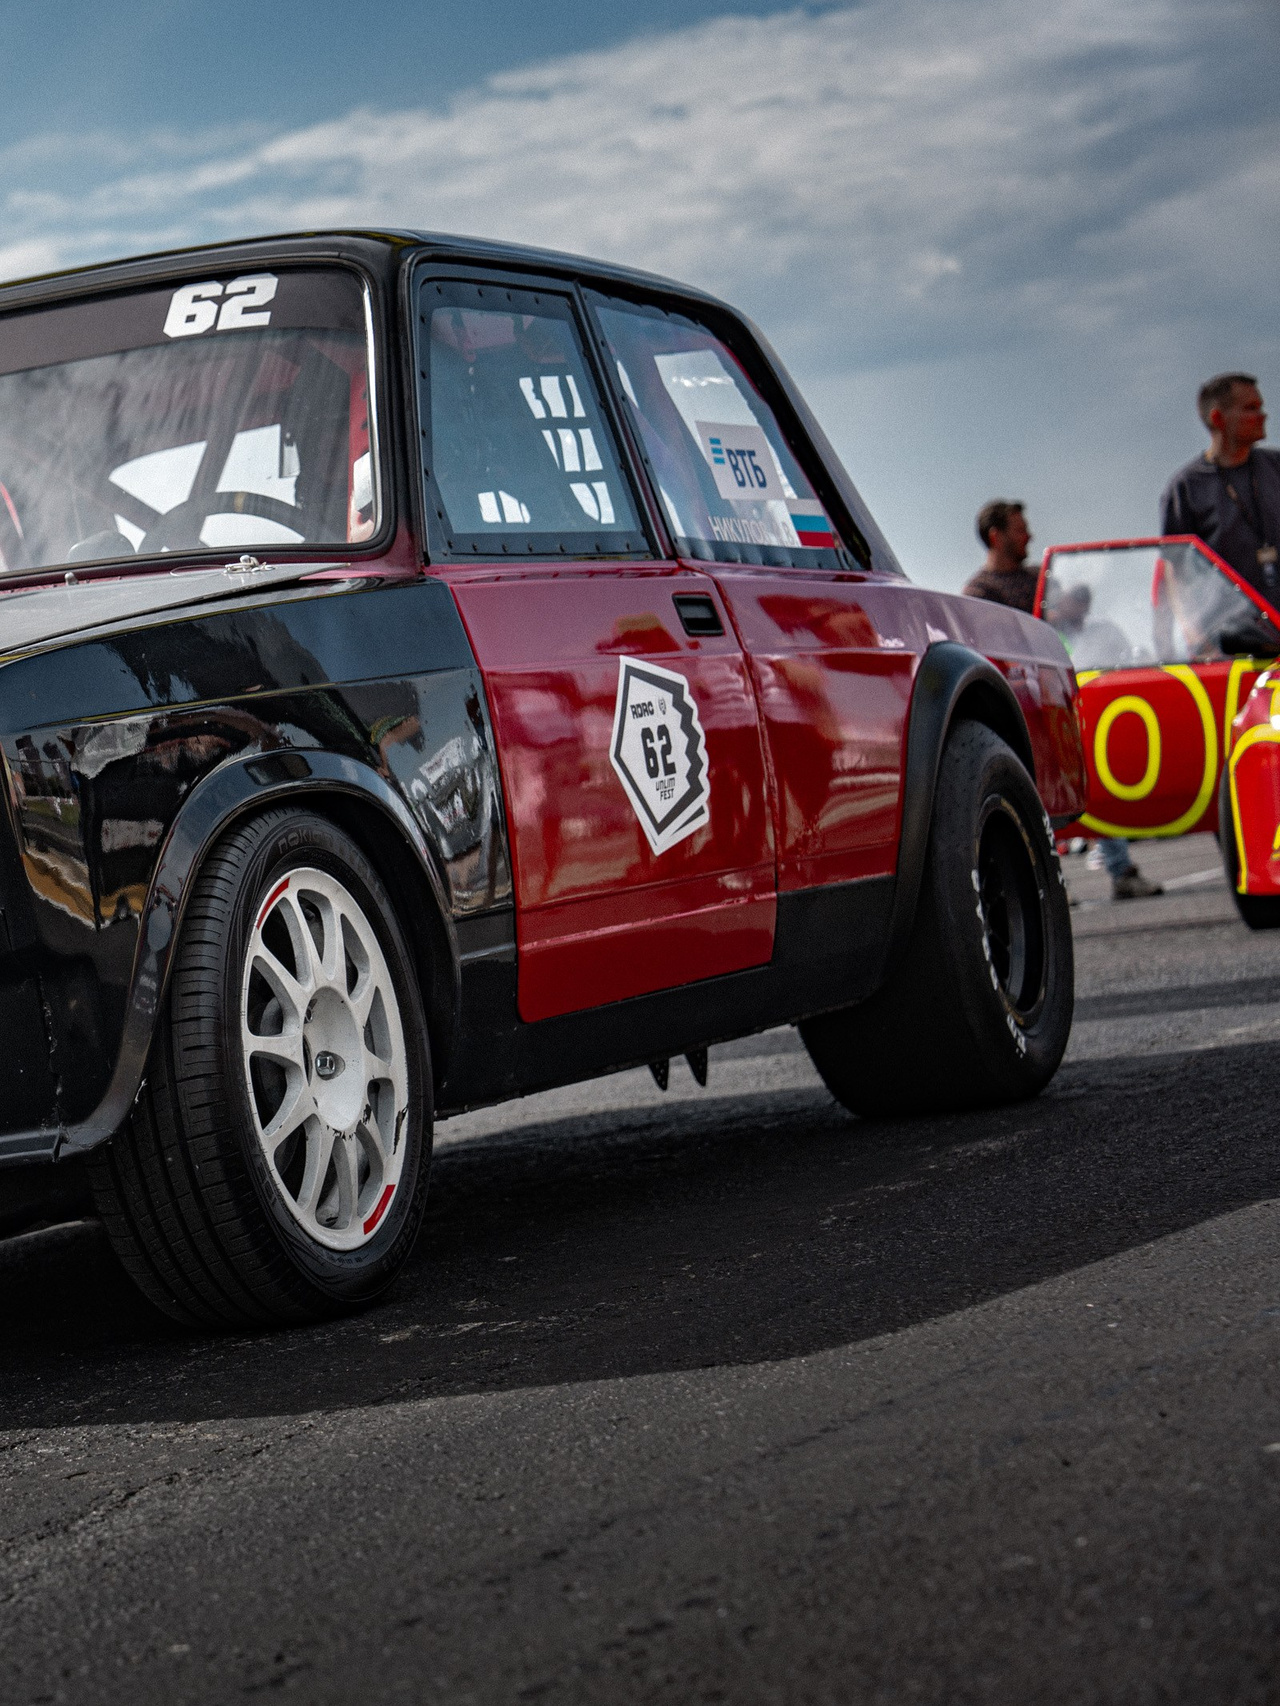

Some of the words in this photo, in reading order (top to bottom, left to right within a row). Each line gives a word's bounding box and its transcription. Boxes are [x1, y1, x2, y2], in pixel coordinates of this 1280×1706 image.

[163, 272, 278, 338] 62
[726, 449, 767, 488] ВТБ
[630, 701, 654, 719] RDRC
[641, 724, 677, 779] 62
[660, 788, 675, 801] FEST
